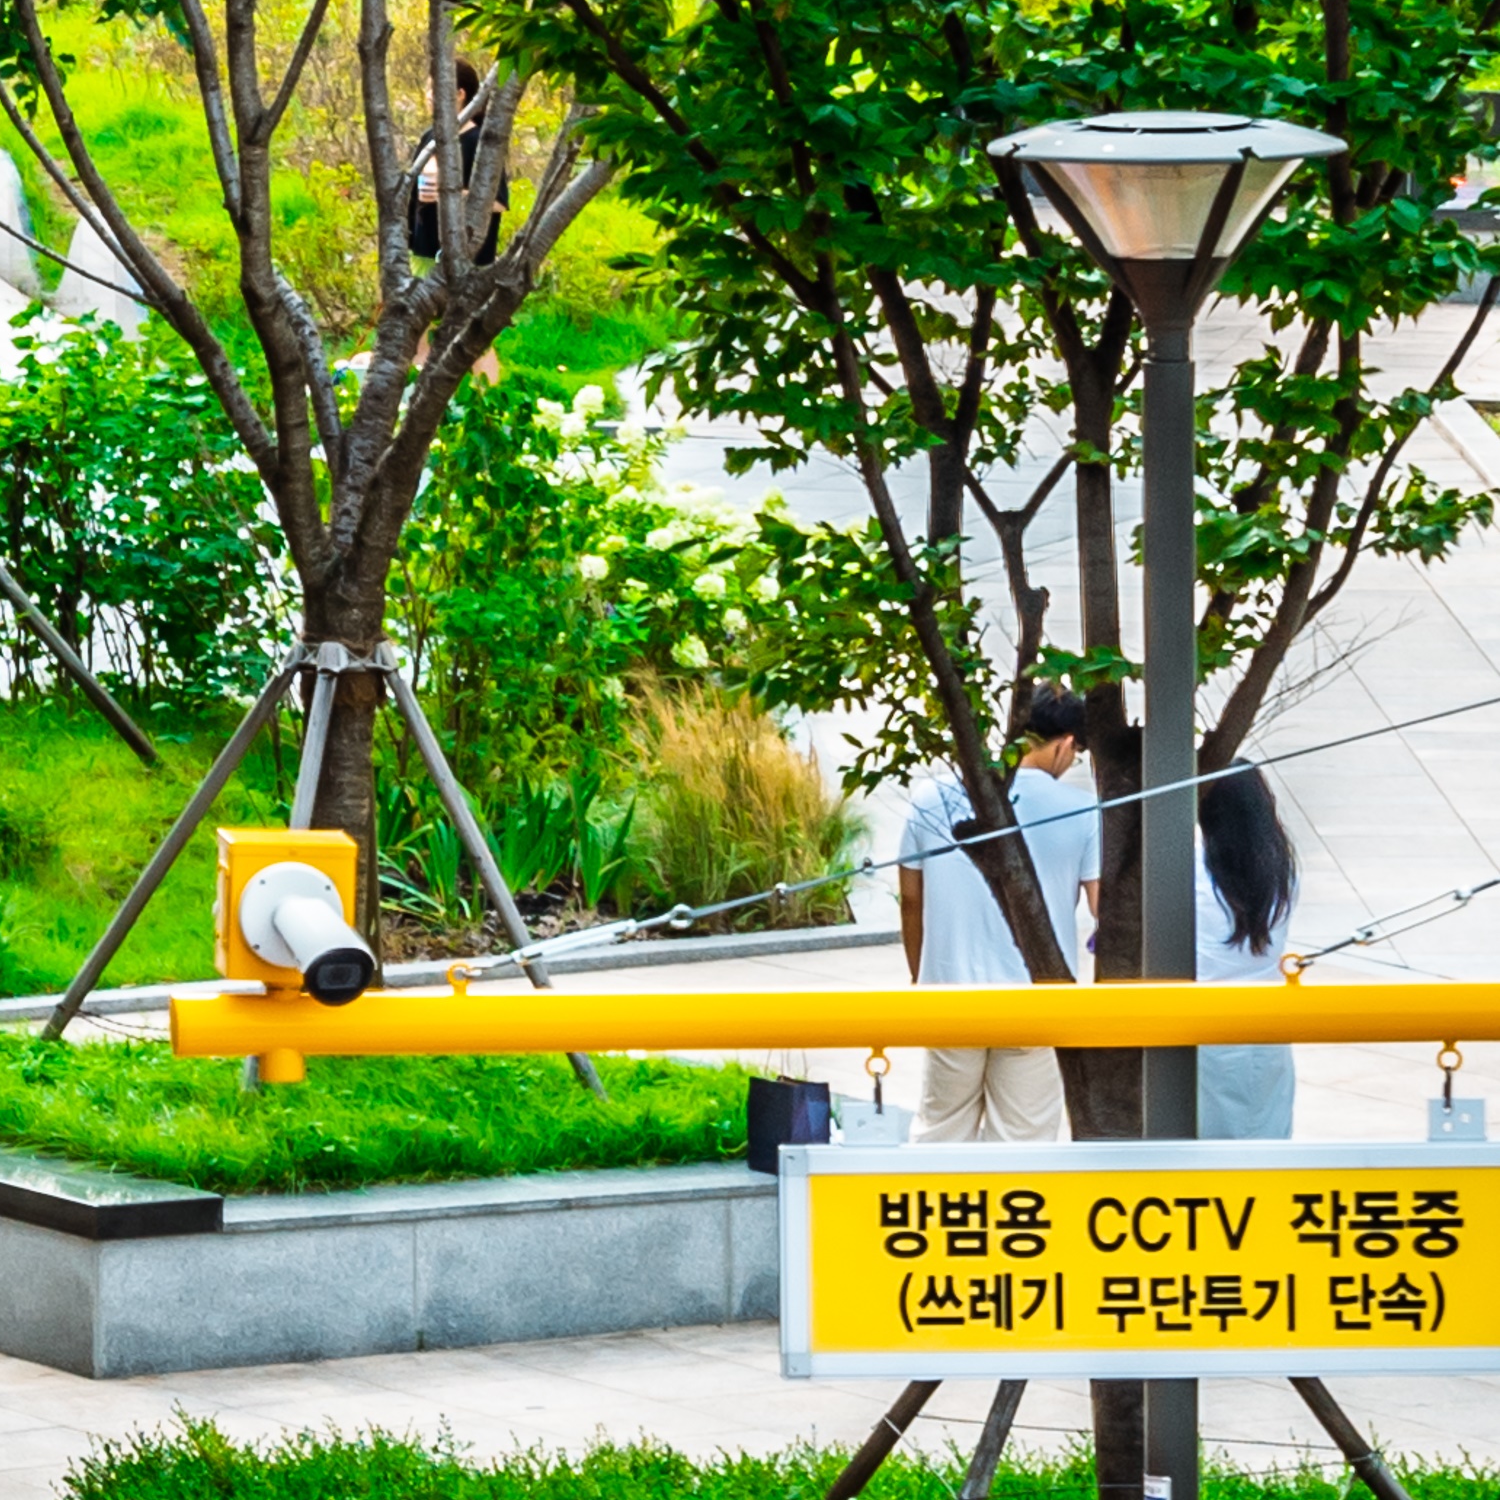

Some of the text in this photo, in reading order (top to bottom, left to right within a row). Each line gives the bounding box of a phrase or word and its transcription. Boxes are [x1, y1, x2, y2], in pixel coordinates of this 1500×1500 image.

[878, 1190, 1465, 1259] 방범용 CCTV 작동중
[898, 1272, 1447, 1333] (쓰레기 무단투기 단속)
